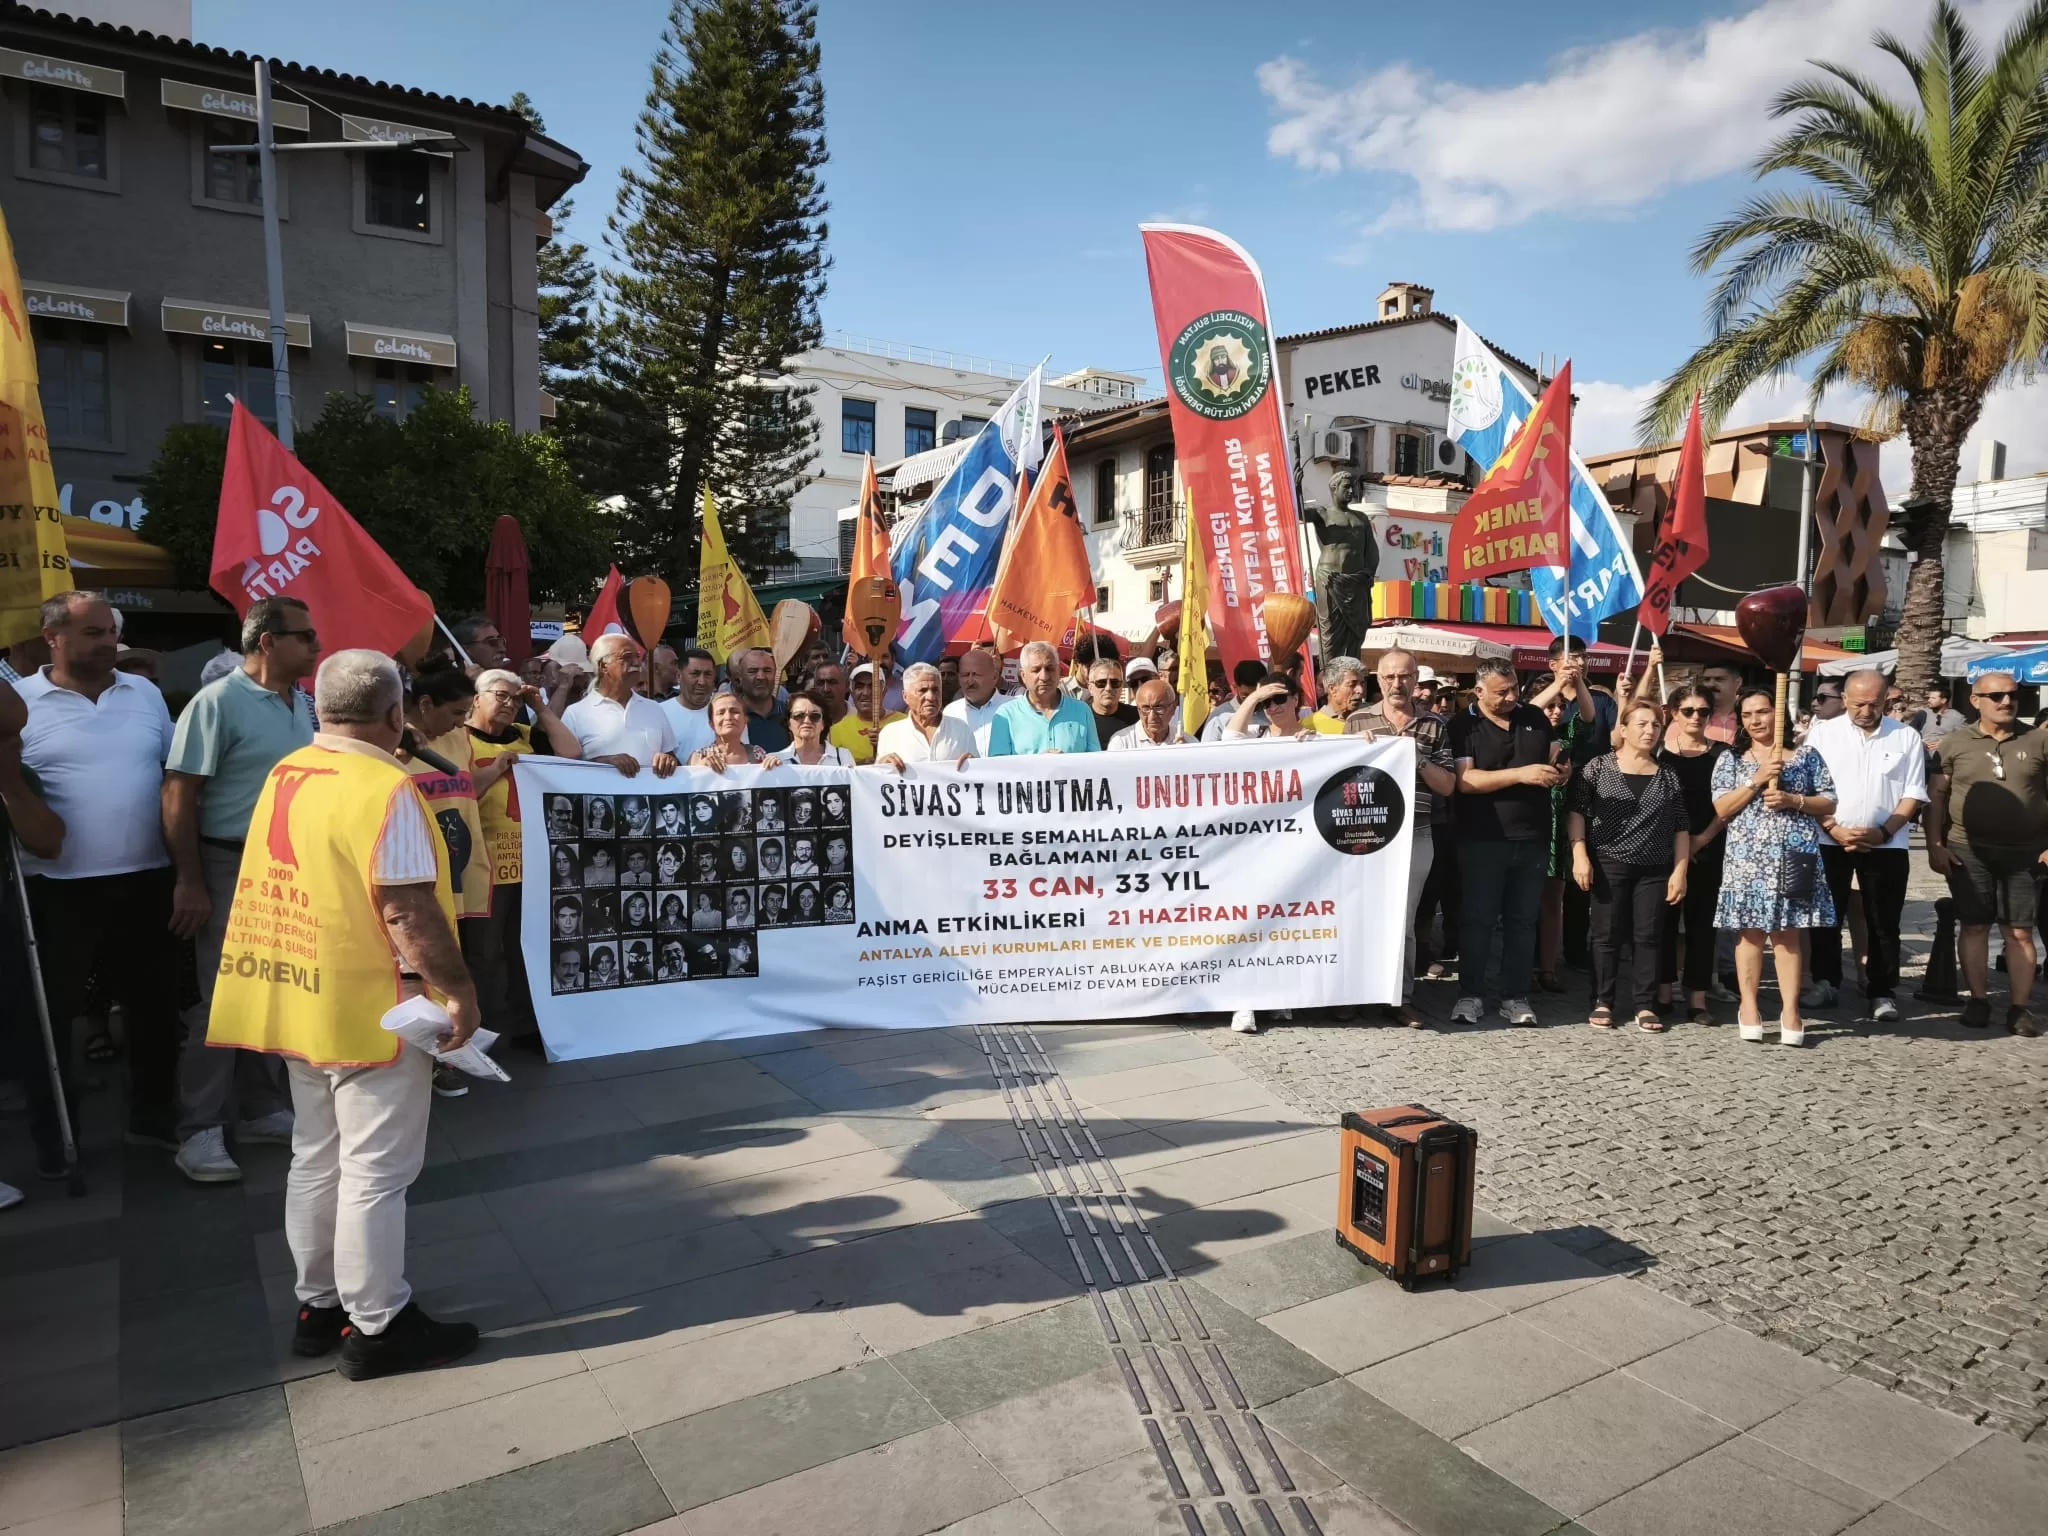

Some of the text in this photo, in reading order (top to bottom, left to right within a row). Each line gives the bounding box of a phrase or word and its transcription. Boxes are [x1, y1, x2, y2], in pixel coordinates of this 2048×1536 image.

[202, 93, 258, 117] GeLatt
[1305, 365, 1382, 399] PEKER
[1000, 599, 1053, 633] HALKEVLERİ
[881, 769, 1303, 817] SİVAS'I UNUTMA, UNUTTURMA
[1357, 782, 1375, 793] CAN
[1358, 793, 1375, 805] YIL
[1331, 806, 1389, 818] SİVAS MADIMAK
[884, 818, 1304, 849] DEYİŞLERLE SEMAHLARLA ALANDAYIZ,
[990, 845, 1200, 867] BAĞLAMANI AL GEL
[983, 870, 1210, 900] 33 CAN, 33 YIL
[857, 919, 928, 938] ANMA
[937, 908, 1085, 934] ETKİNLİKERİ
[1108, 910, 1130, 926] 21
[1139, 903, 1248, 924] HAZİRAN
[1257, 900, 1336, 920] PAZAR
[859, 927, 1338, 962] ANTALYA ALEVİ KURUMLARI EMEK VE DEMOKRASİ GÜÇLERİ
[219, 951, 320, 995] GÖREVLİ
[858, 953, 1338, 988] FAŞİST GERİCİLİĞE EMPERYALİST ABLUKAYA KARŞI ALANLARDAYIZ
[978, 973, 1221, 996] MÜCADELEMİZ DEVAM EDECEKTİR
